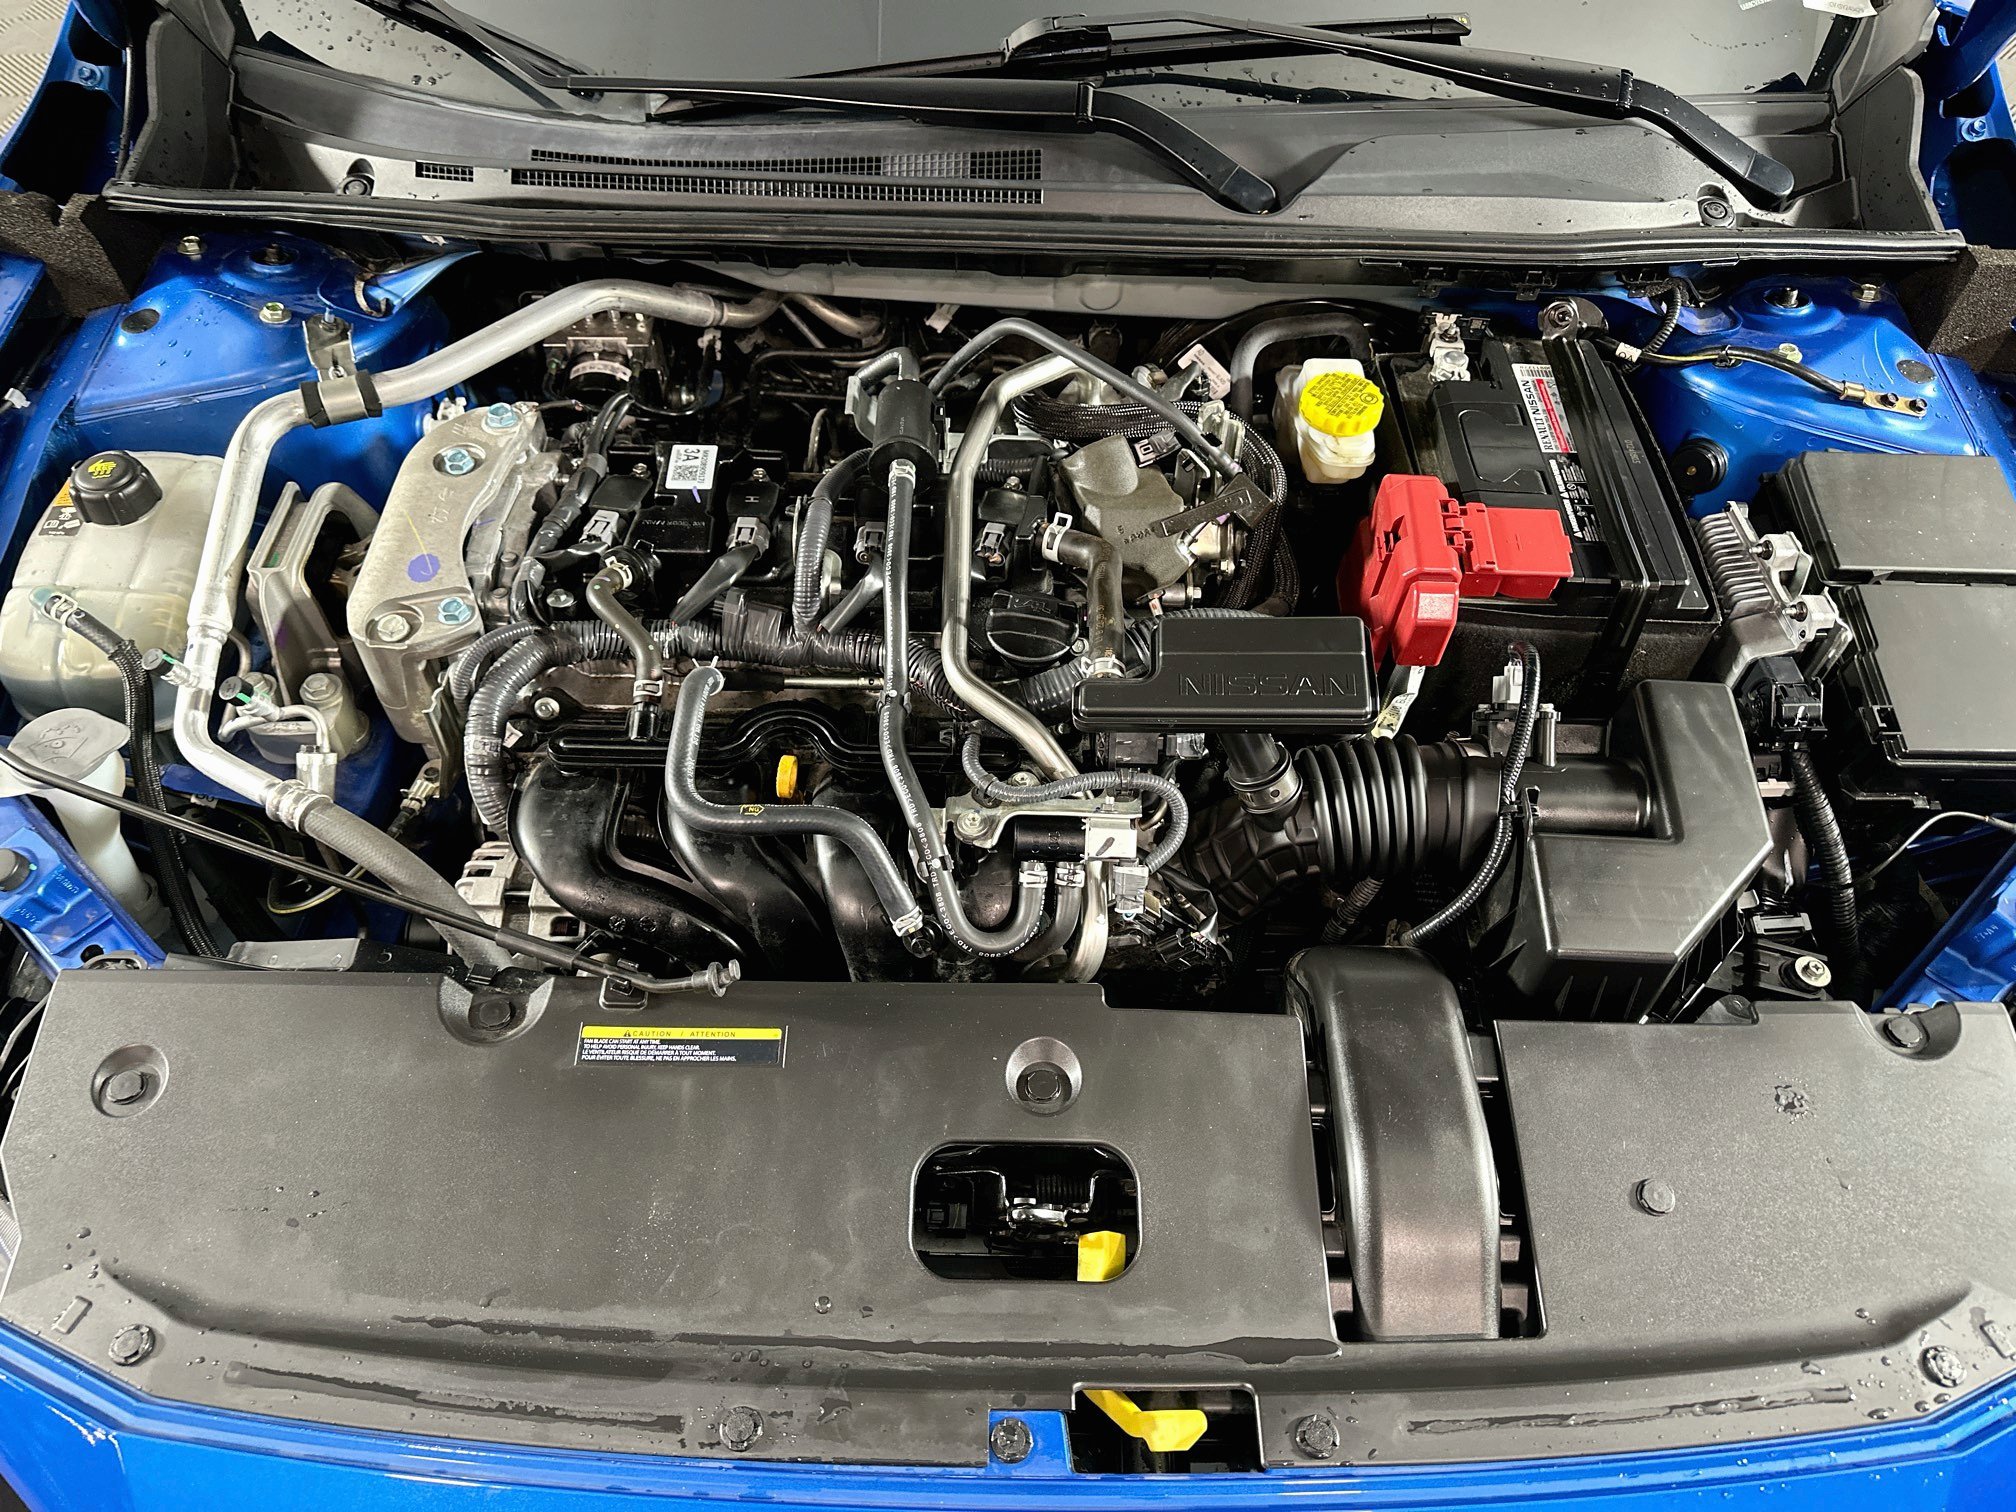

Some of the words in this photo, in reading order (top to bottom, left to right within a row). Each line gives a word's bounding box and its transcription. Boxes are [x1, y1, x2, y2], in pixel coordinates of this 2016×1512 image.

[1521, 380, 1540, 415] NISSAN
[1534, 417, 1553, 450] RENAULT
[682, 448, 701, 462] 3A
[1178, 673, 1357, 696] NISSAN
